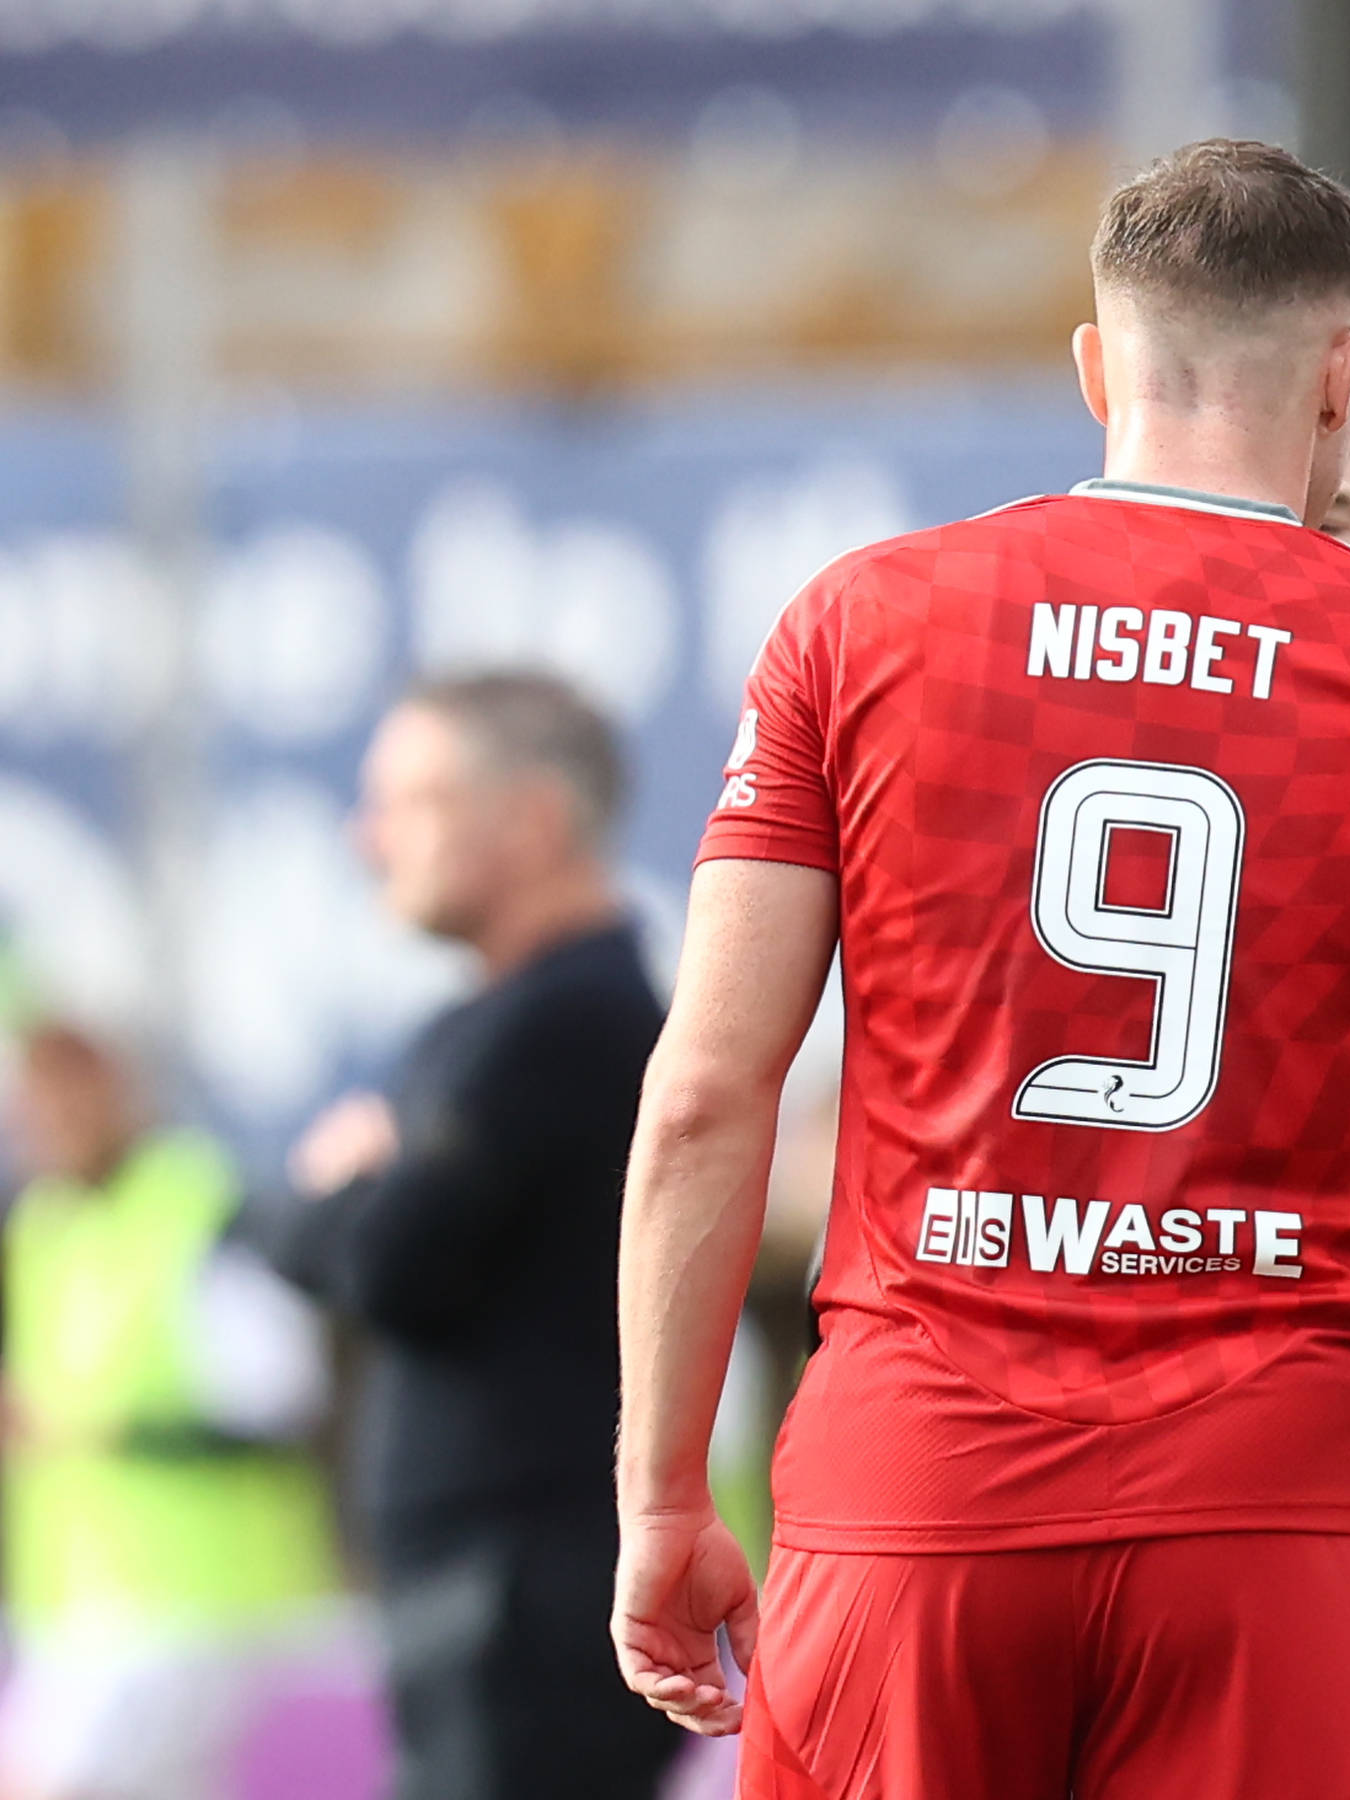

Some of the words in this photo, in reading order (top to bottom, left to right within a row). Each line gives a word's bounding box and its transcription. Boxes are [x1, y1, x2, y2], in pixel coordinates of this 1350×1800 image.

[1026, 602, 1292, 699] NISBET
[1011, 757, 1246, 1132] 9
[917, 1195, 1012, 1266] EIS
[1022, 1195, 1303, 1278] WASTE
[1100, 1250, 1241, 1275] SERVICES
